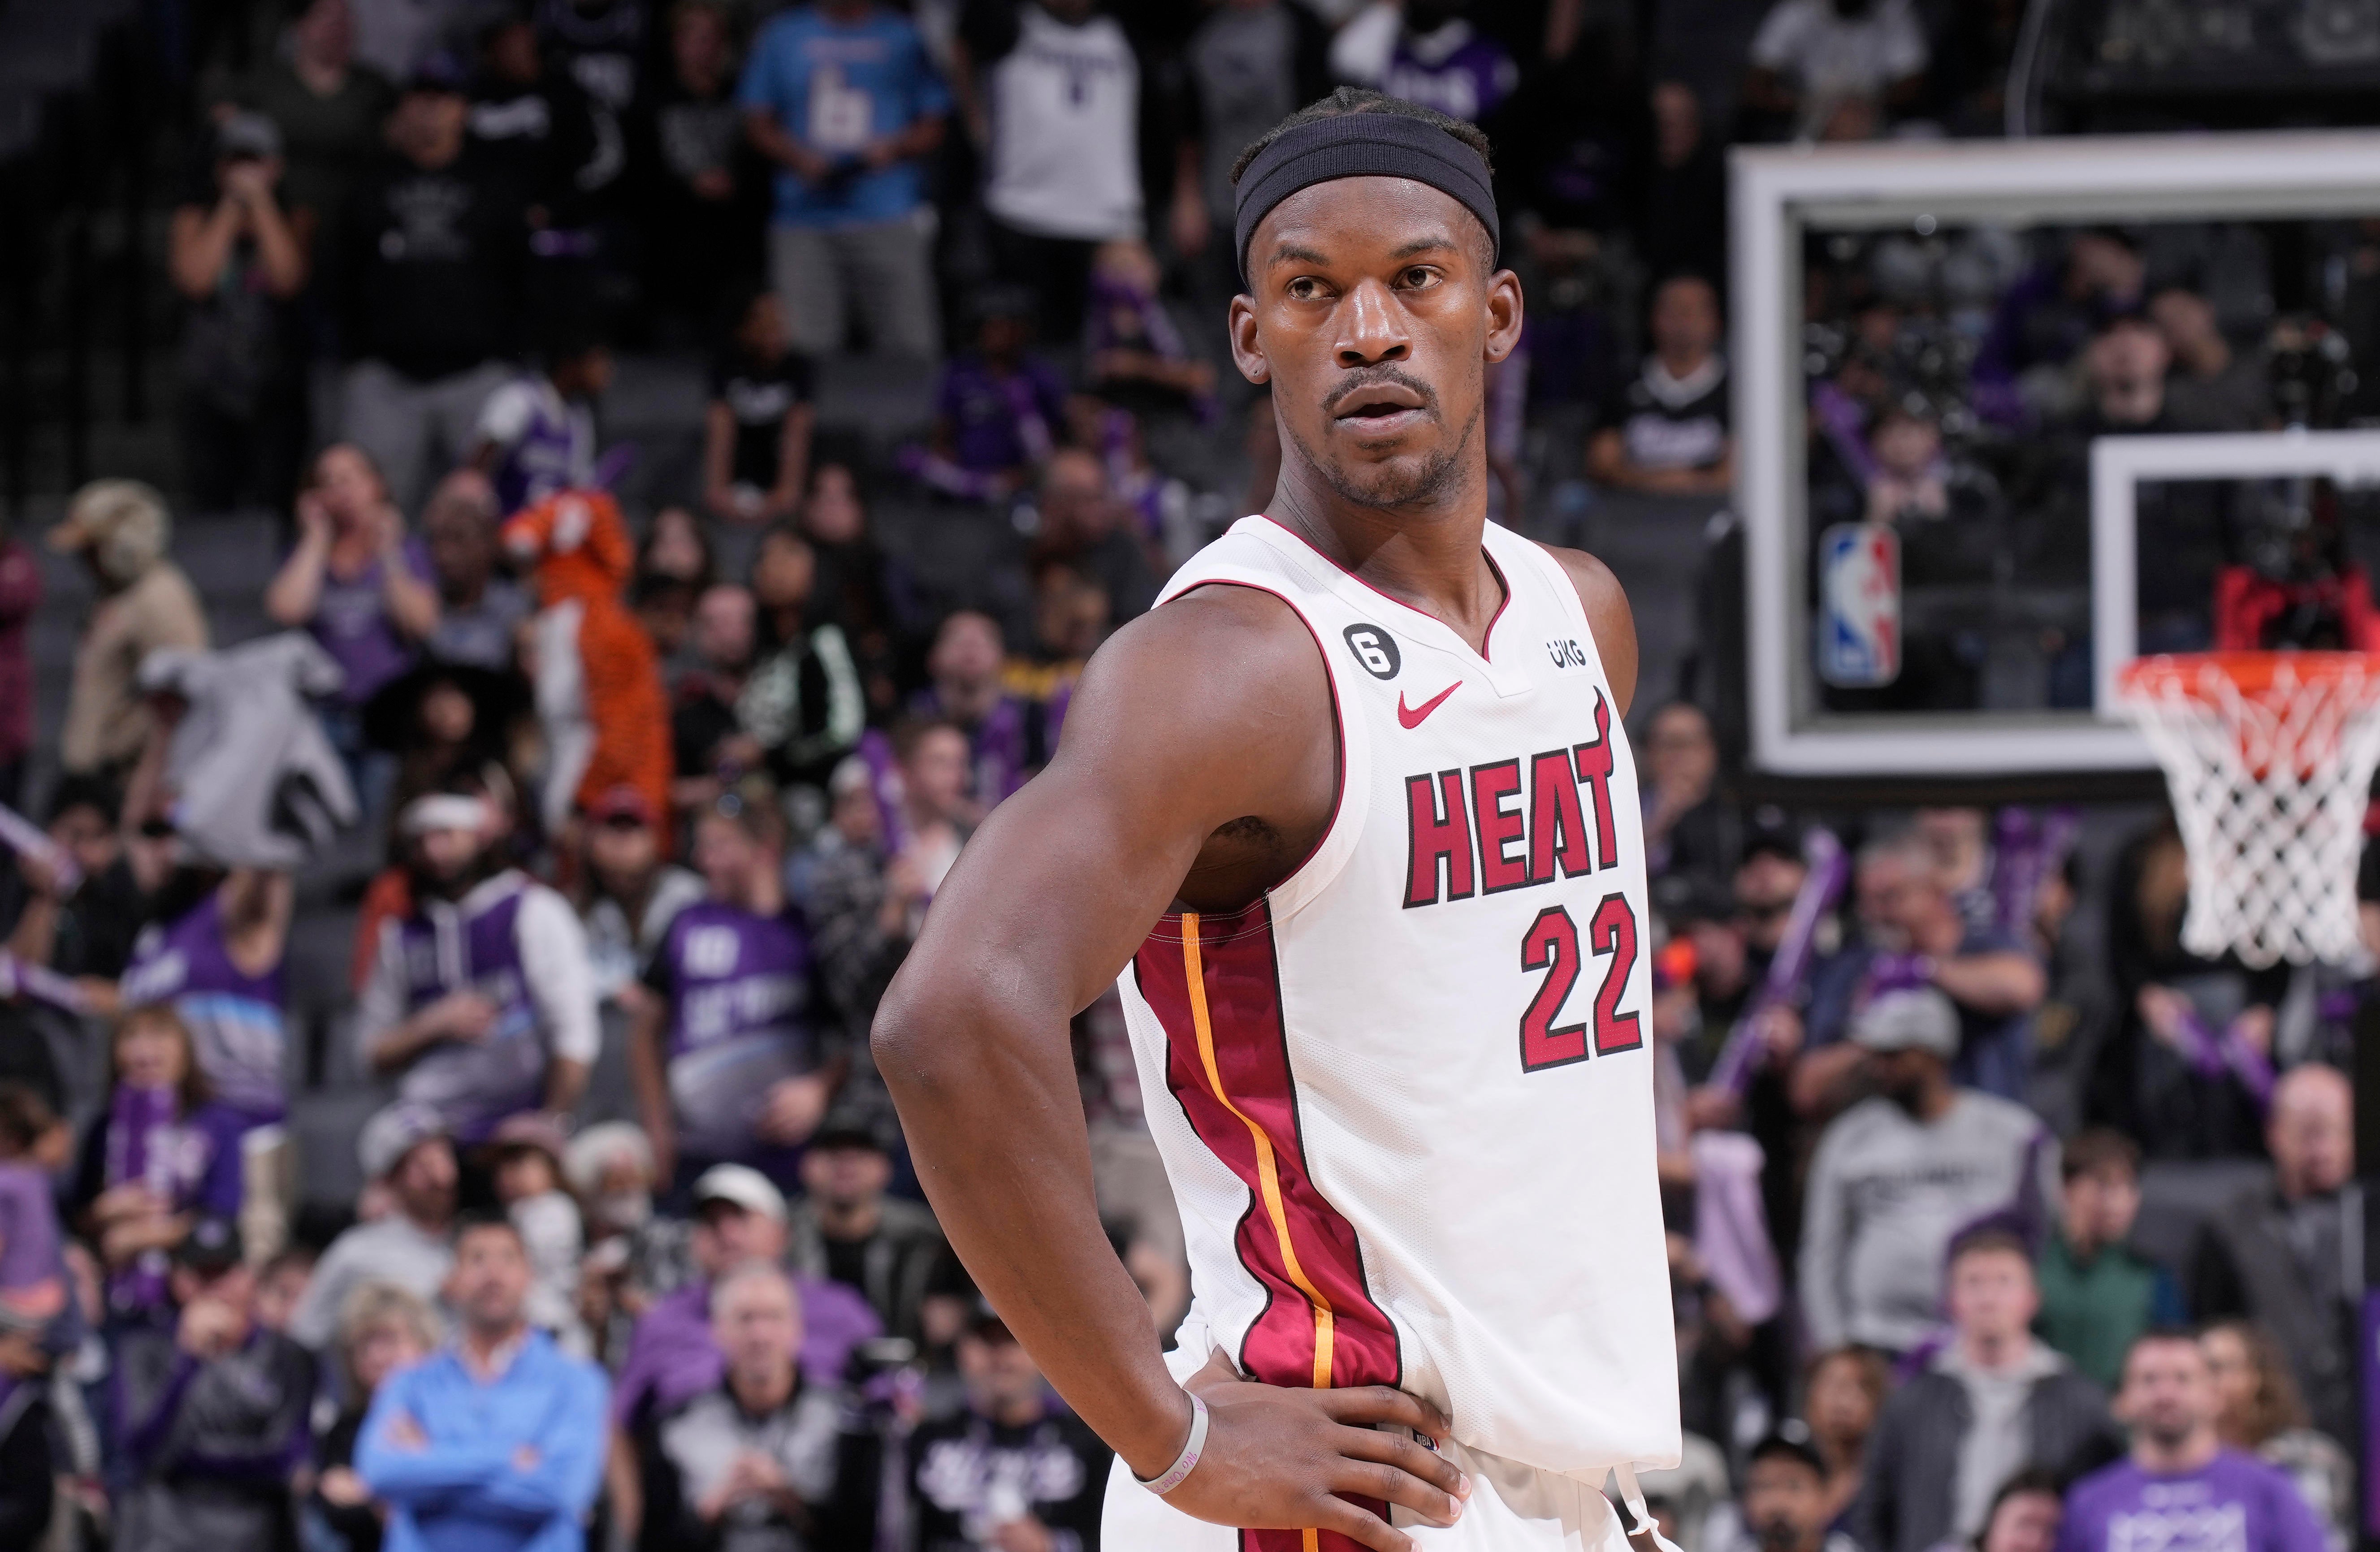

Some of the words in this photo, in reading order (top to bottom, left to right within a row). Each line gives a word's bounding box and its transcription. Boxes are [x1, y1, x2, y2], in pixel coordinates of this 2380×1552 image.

[1351, 631, 1391, 672] 6
[1402, 685, 1618, 909] HEAT
[1519, 892, 1644, 1074] 22
[1416, 1434, 1431, 1447] NBA
[1182, 1452, 1198, 1469] No
[1162, 1471, 1185, 1488] One
